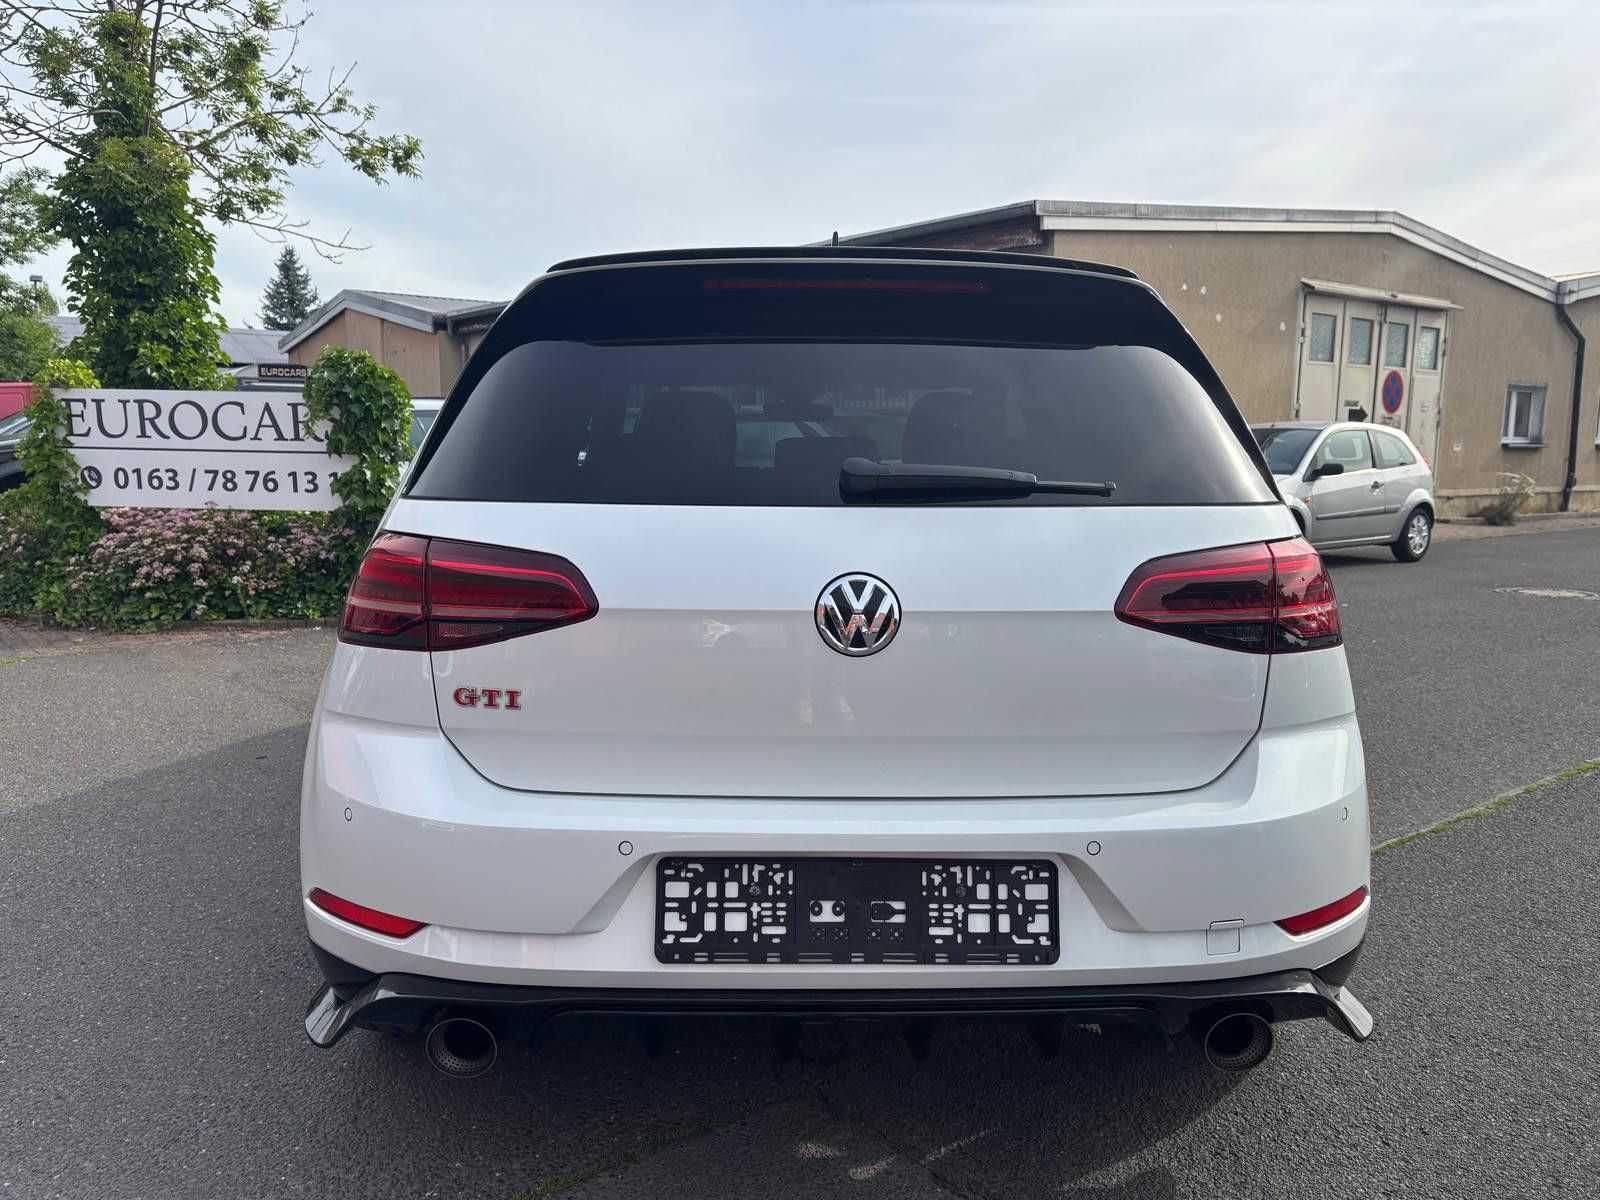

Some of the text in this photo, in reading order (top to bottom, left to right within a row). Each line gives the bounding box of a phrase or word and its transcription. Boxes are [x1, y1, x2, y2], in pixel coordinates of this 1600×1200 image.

[260, 367, 307, 377] EUROCARS
[113, 467, 180, 491] 0163
[204, 469, 238, 492] 78
[245, 470, 279, 493] 76
[287, 471, 319, 494] 13
[453, 687, 522, 710] GTI
